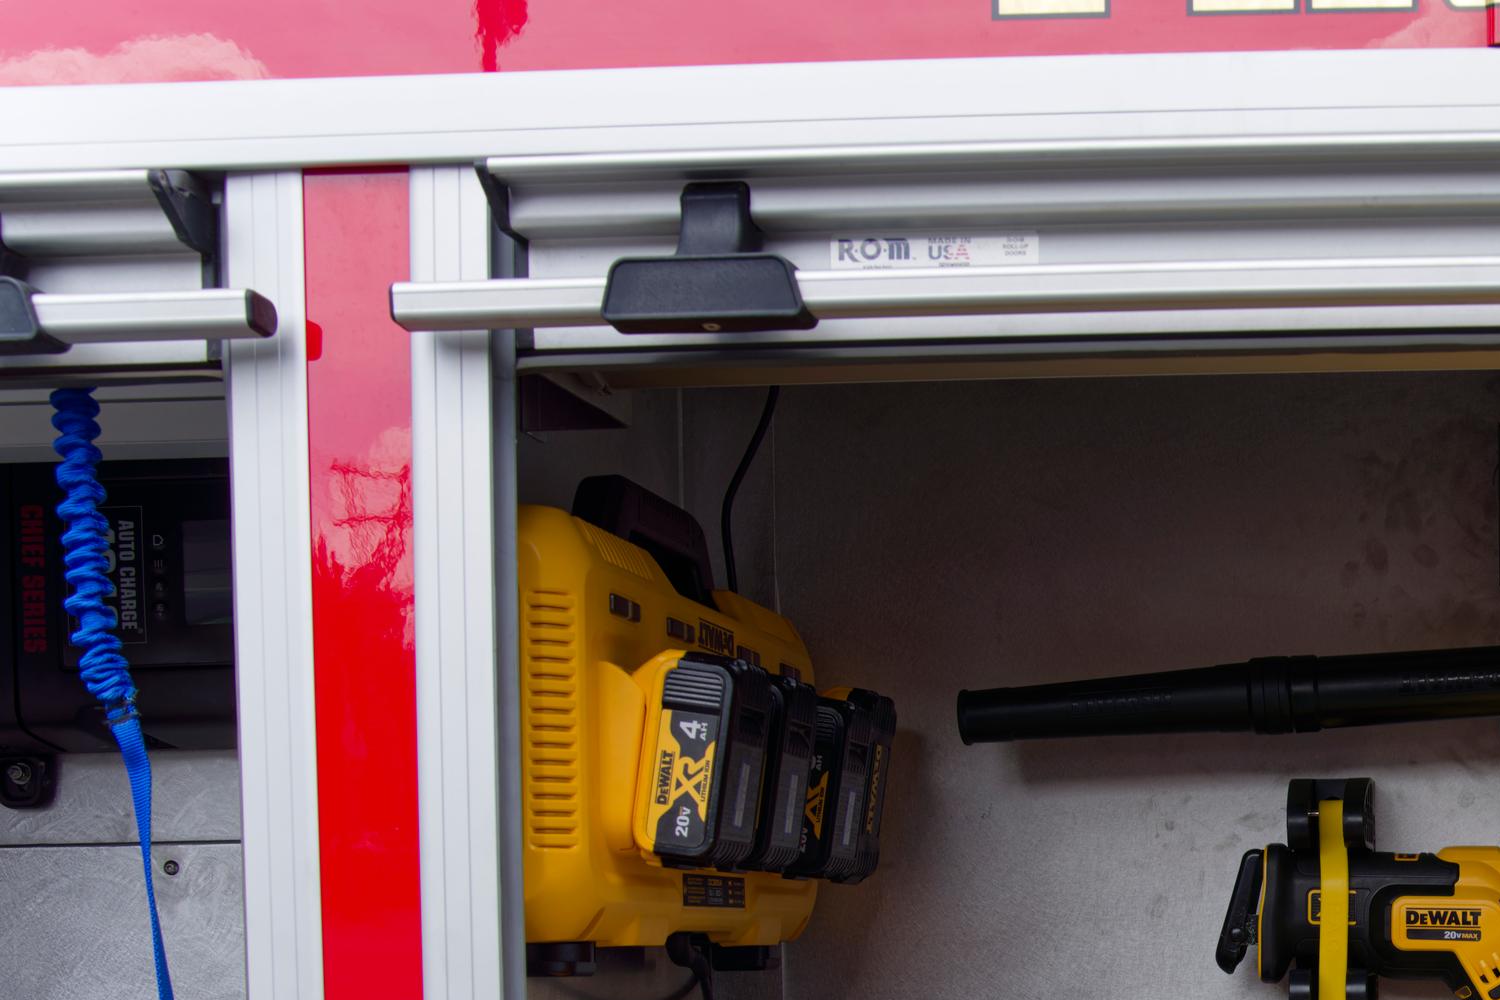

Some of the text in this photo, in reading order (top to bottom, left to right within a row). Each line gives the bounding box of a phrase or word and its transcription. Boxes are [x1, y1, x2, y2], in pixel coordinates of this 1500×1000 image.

[928, 244, 971, 261] USA
[19, 504, 47, 654] CHIEF SERIES
[117, 520, 138, 631] AUTO CHARGE
[679, 720, 701, 739] 4
[699, 722, 709, 742] AH
[655, 750, 674, 805] DEWALT
[673, 756, 704, 805] XR
[1405, 909, 1482, 926] DEWALT
